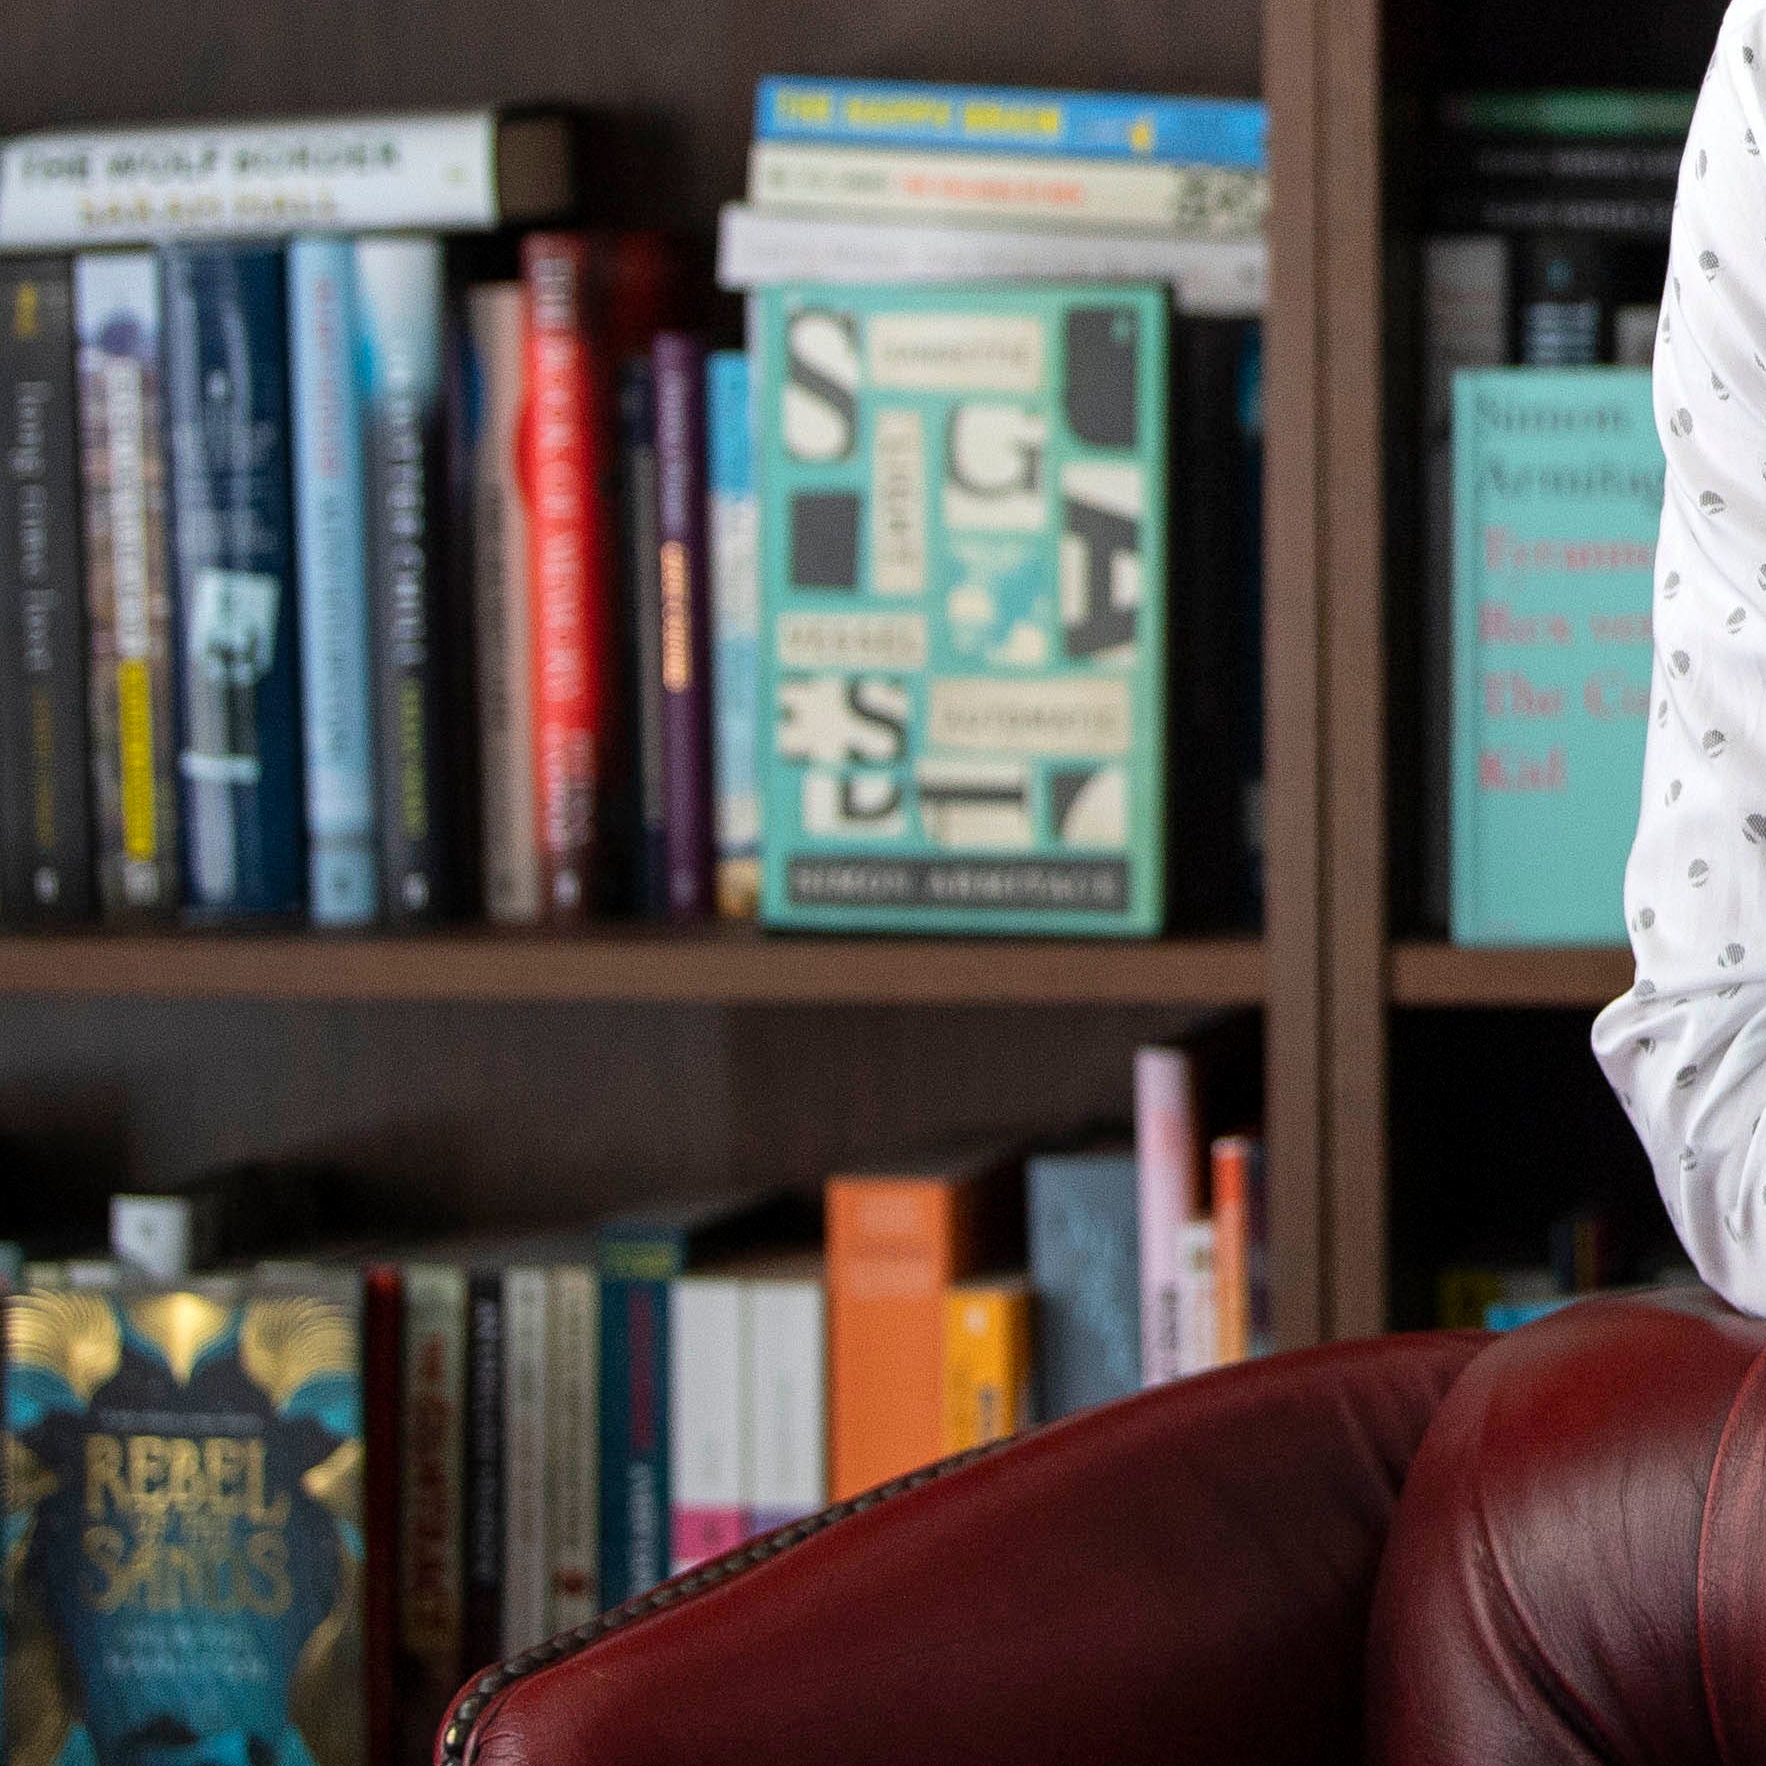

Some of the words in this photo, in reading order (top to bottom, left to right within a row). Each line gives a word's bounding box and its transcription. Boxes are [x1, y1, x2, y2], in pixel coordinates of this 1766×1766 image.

[775, 88, 833, 124] THE
[962, 98, 1060, 135] BRAIN
[20, 148, 94, 190] THE
[102, 144, 221, 185] WOLF
[232, 137, 404, 178] BORDER
[1475, 392, 1633, 434] Simon
[1479, 454, 1663, 520] Armitag
[1482, 601, 1572, 646] Rex
[1486, 672, 1563, 720] The
[1482, 747, 1568, 795] Kid
[86, 1434, 293, 1528] REBEL
[80, 1524, 294, 1616] SANDS
